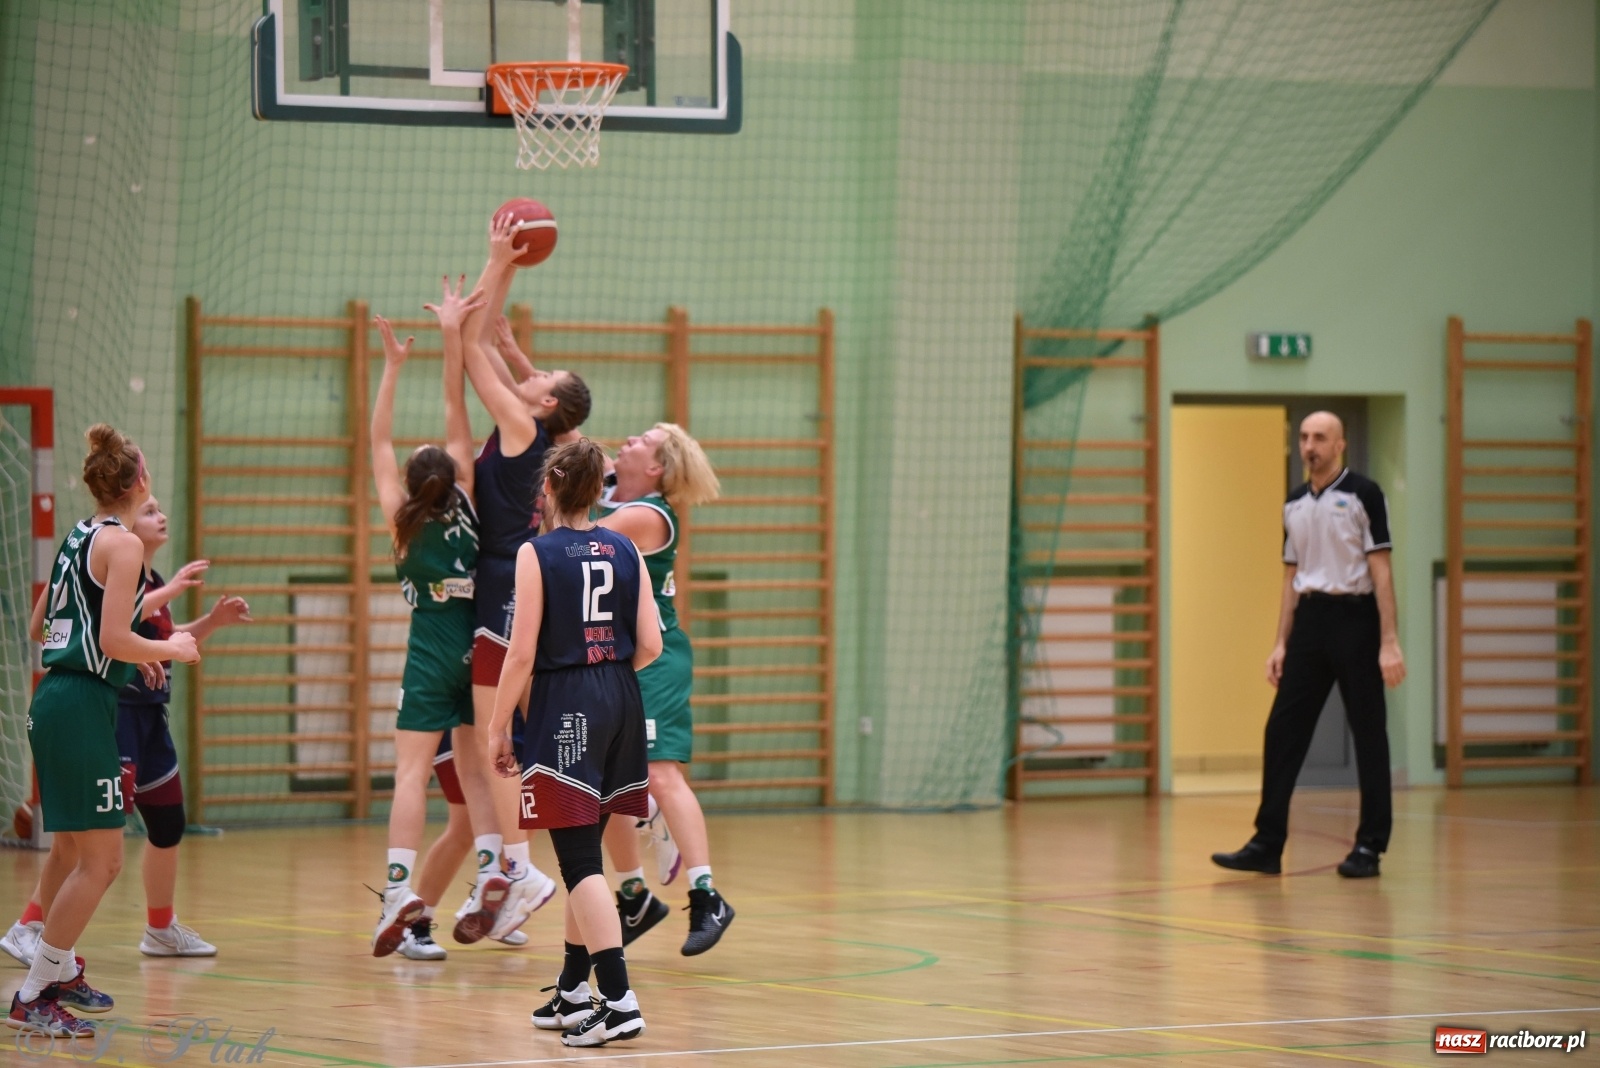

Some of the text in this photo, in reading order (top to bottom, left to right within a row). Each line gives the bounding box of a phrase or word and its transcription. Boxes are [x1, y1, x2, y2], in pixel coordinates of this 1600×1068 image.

[581, 560, 614, 622] 12
[96, 776, 124, 813] 35
[521, 791, 538, 819] 12
